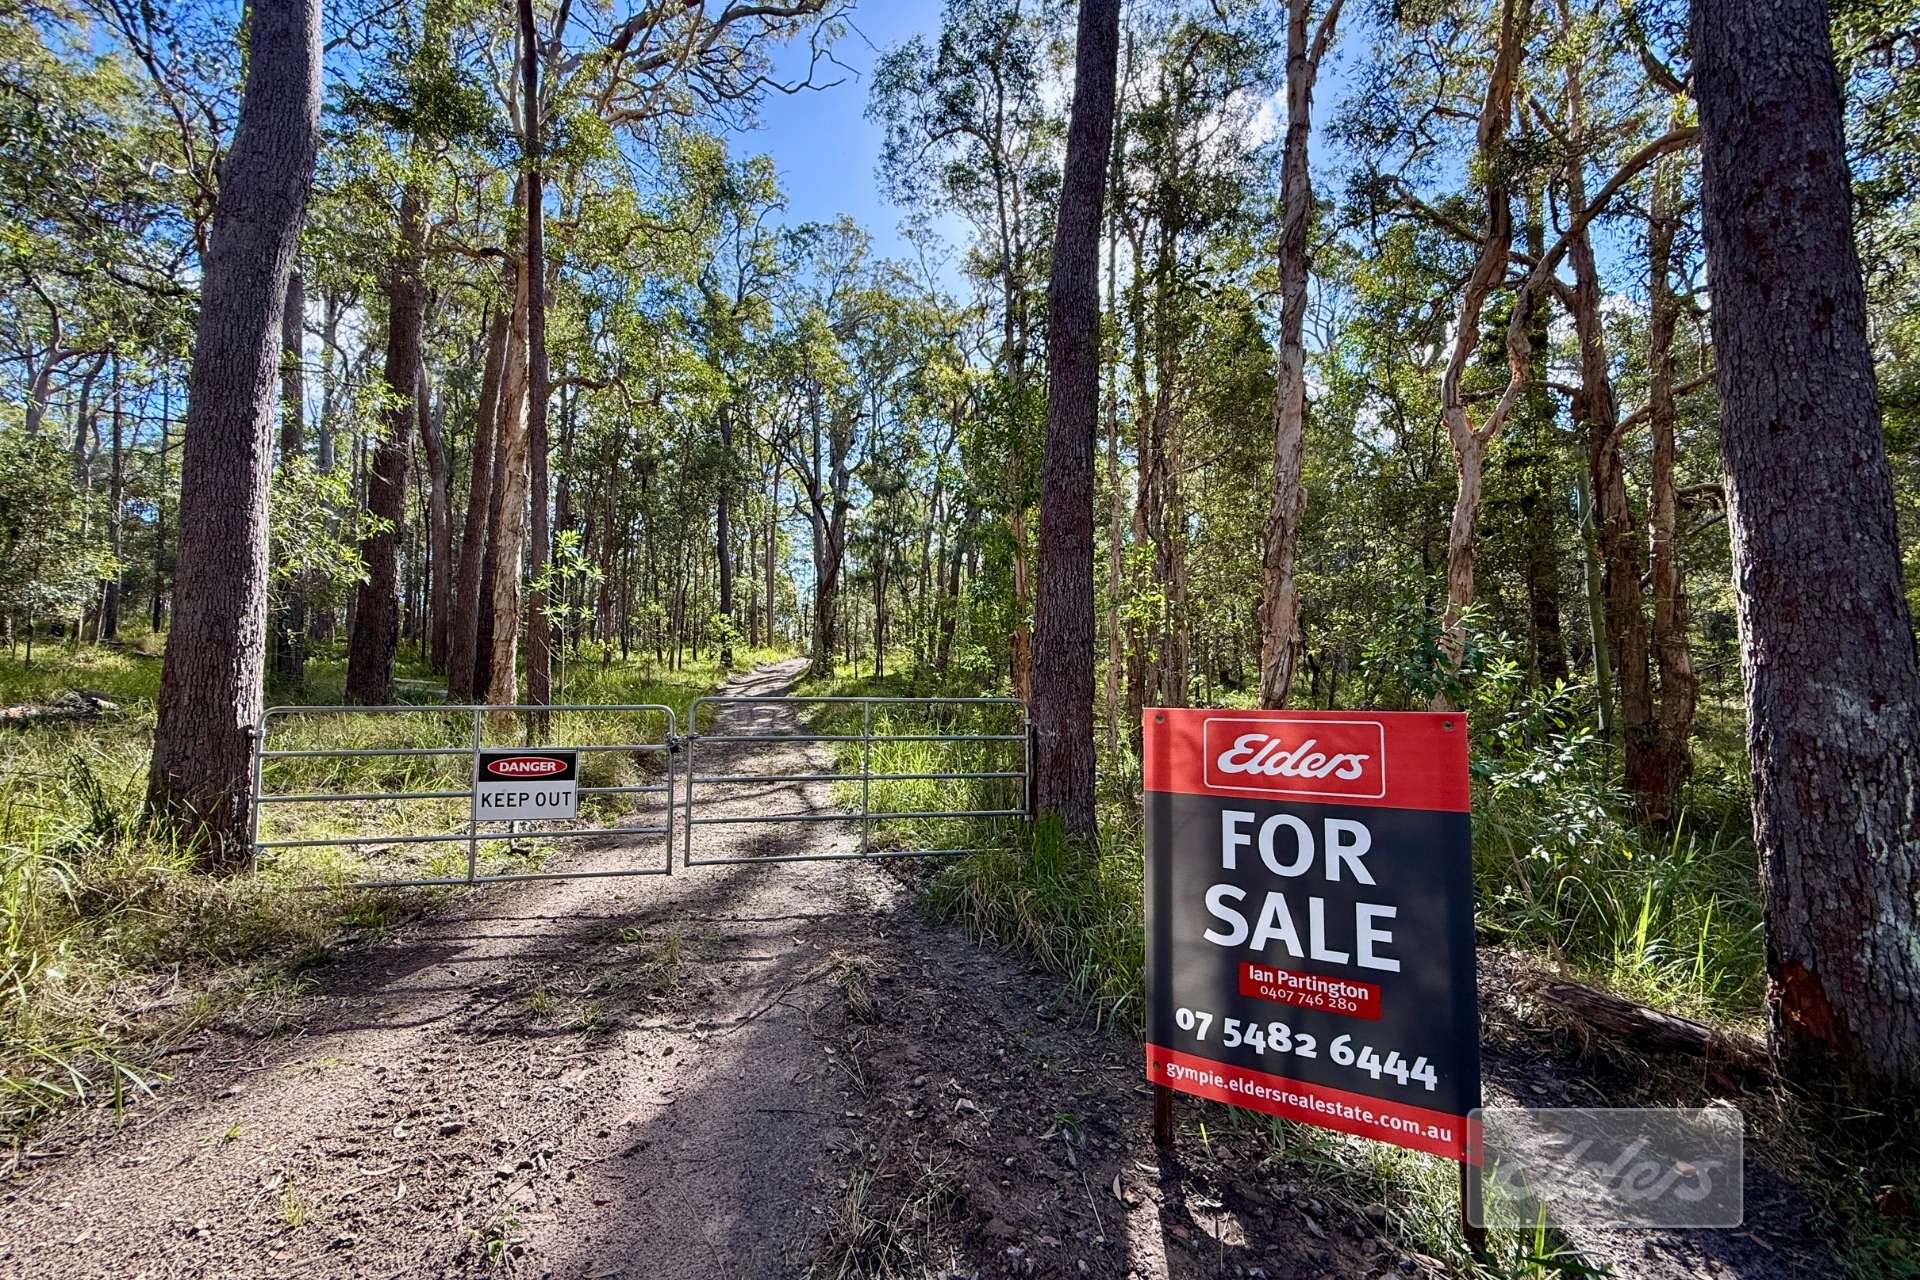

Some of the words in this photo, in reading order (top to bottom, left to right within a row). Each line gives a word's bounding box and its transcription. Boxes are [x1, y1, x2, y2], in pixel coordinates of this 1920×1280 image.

[499, 761, 556, 772] DANGER
[1217, 733, 1369, 780] Elders
[481, 792, 530, 808] KEEP
[535, 791, 572, 807] OUT
[1222, 810, 1377, 886] FOR
[1202, 883, 1401, 973] SALE
[1249, 965, 1274, 983] Ian
[1277, 970, 1369, 1000] Partington
[1260, 985, 1294, 1002] 0407
[1298, 992, 1324, 1007] 746
[1328, 997, 1357, 1012] 280
[1175, 1007, 1214, 1041] 07
[1223, 1017, 1317, 1059] 5482
[1329, 1034, 1438, 1091] 6444
[1166, 1061, 1452, 1143] gympie.eldersrealestate.com.au
